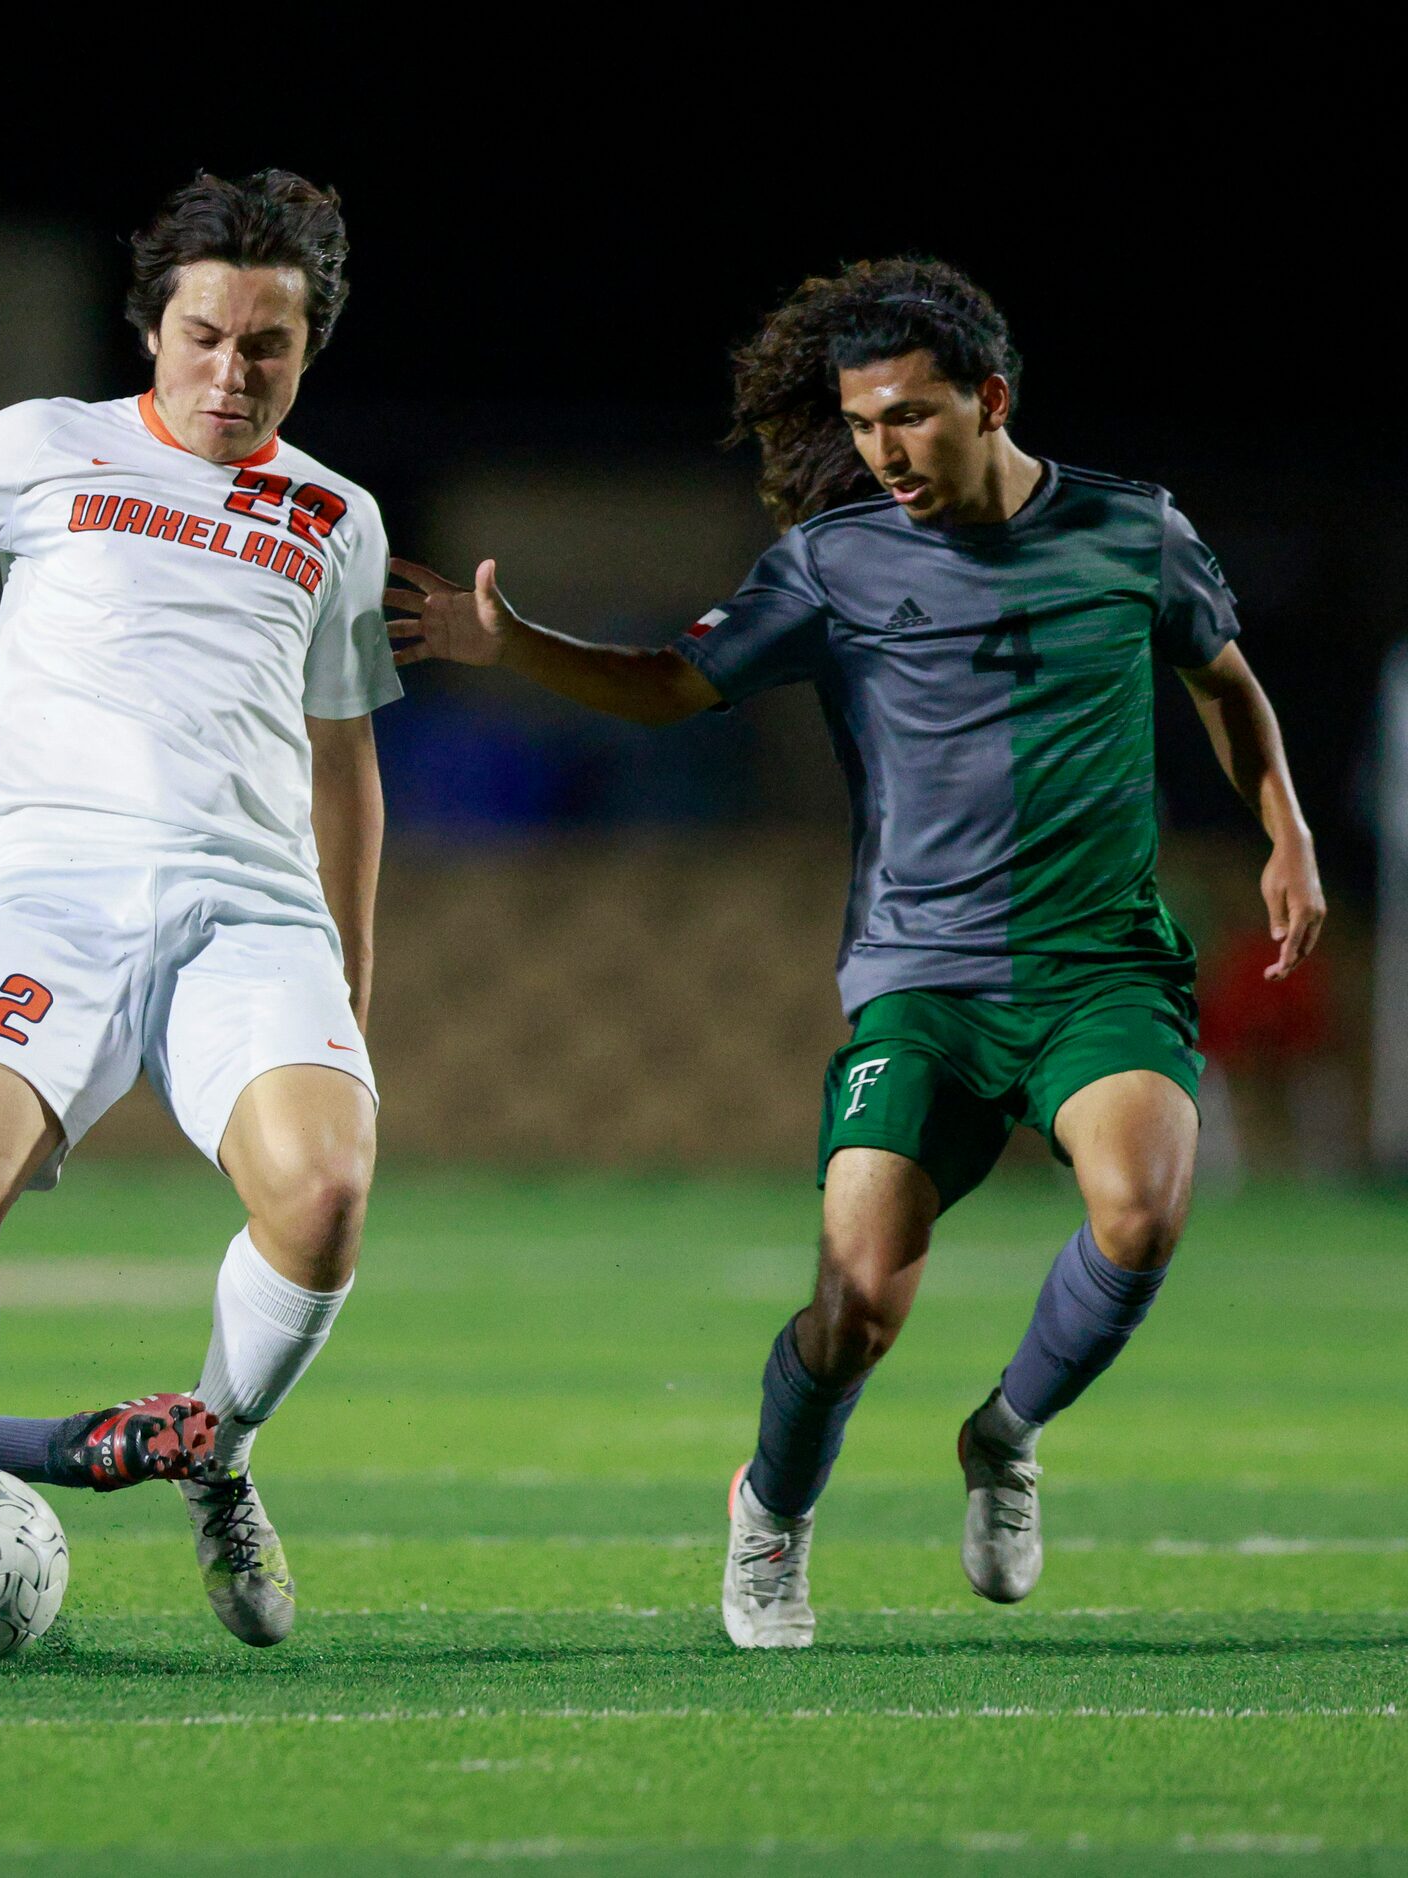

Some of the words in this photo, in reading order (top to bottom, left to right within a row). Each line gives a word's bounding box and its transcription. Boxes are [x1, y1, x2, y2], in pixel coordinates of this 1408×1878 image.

[68, 494, 324, 595] WAKELAND
[224, 469, 347, 550] 22
[884, 616, 933, 631] adidas
[972, 609, 1044, 687] 4
[101, 1434, 116, 1476] COPA
